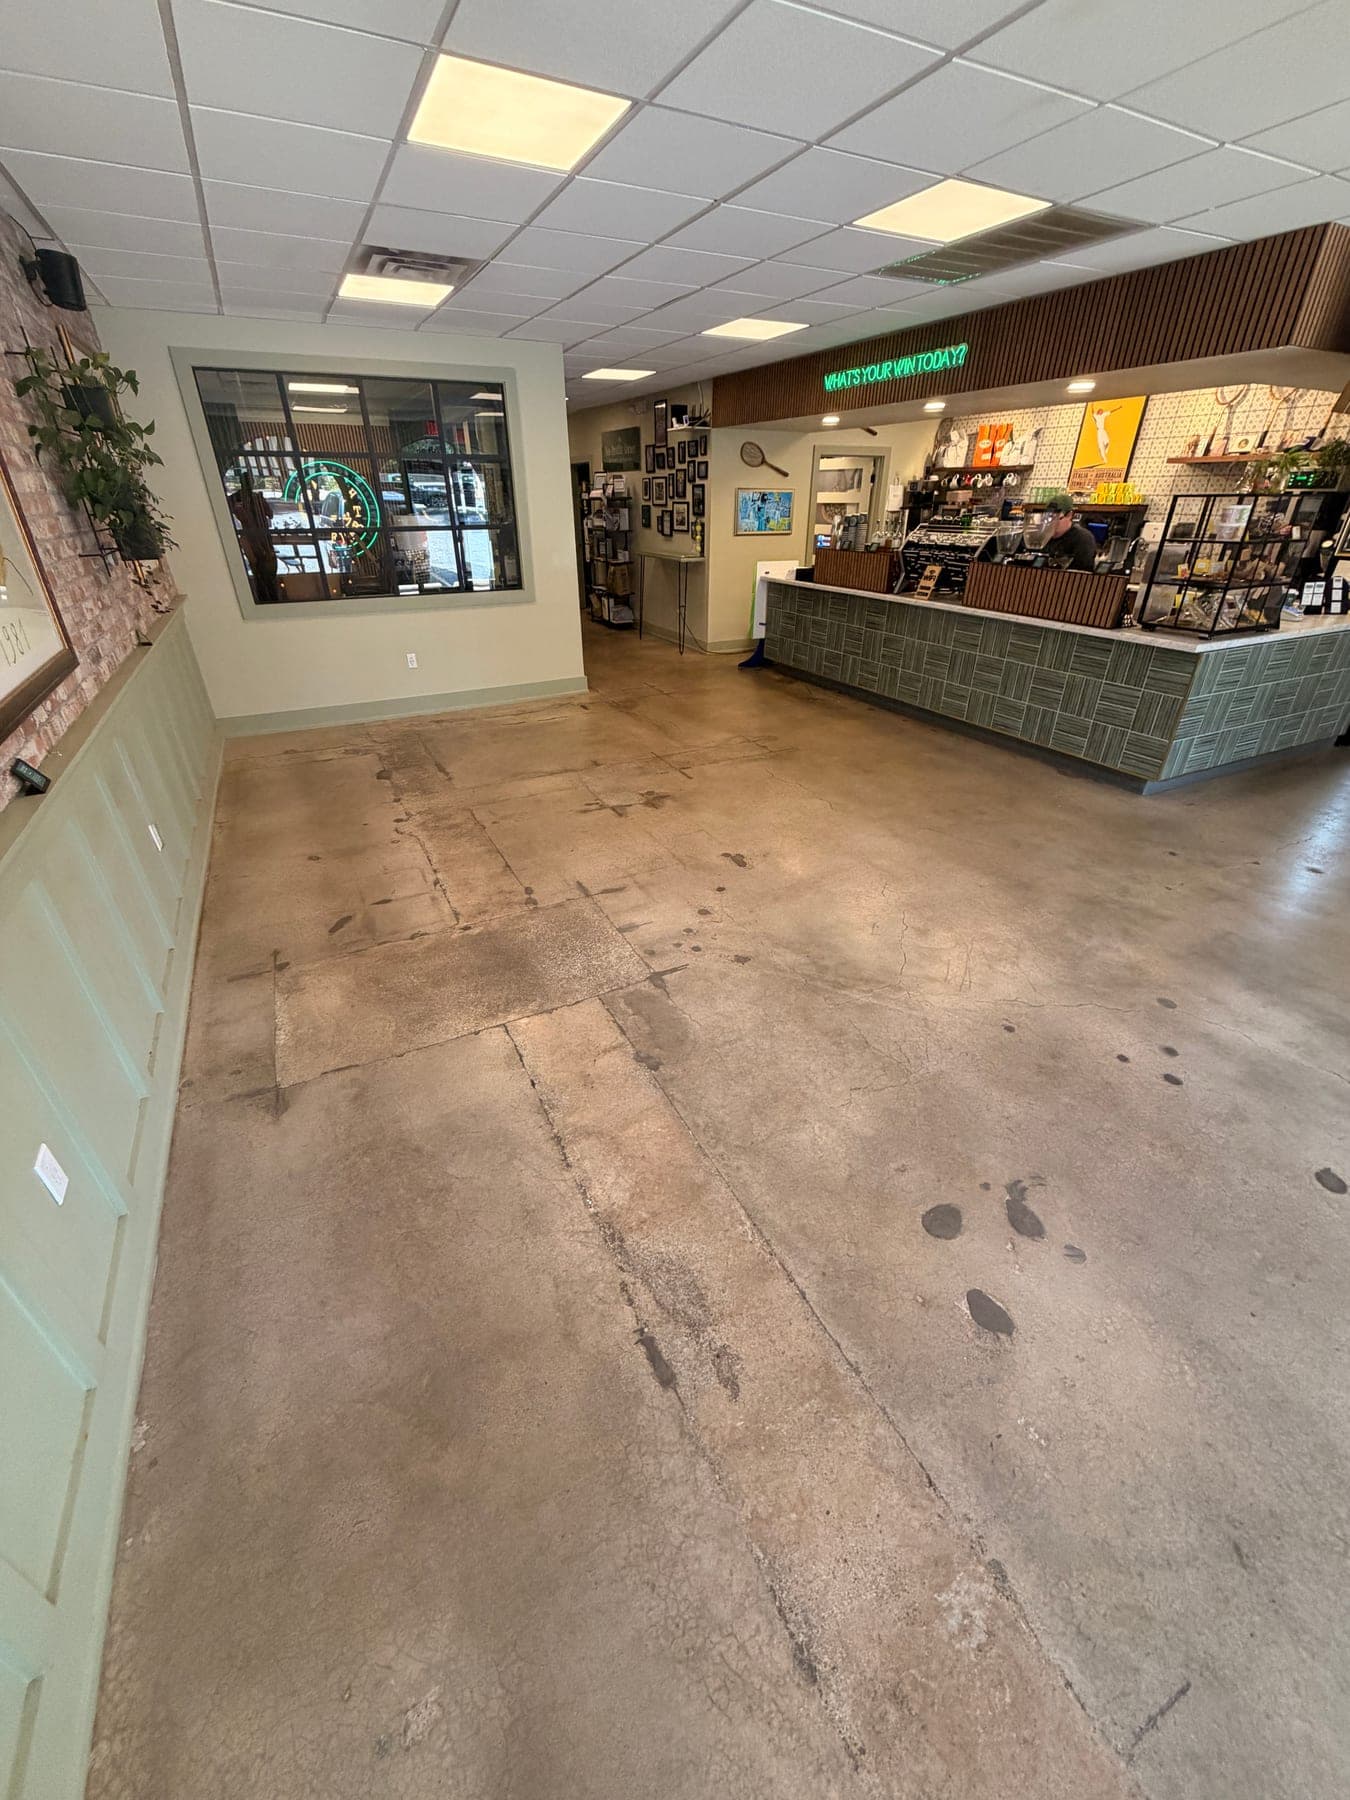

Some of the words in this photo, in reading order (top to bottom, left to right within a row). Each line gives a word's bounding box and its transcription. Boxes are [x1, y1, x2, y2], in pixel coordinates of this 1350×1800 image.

[825, 369, 861, 391] WHAT'S
[861, 361, 892, 383] YOUR
[893, 355, 916, 377] WIN
[915, 343, 968, 372] TODAY?
